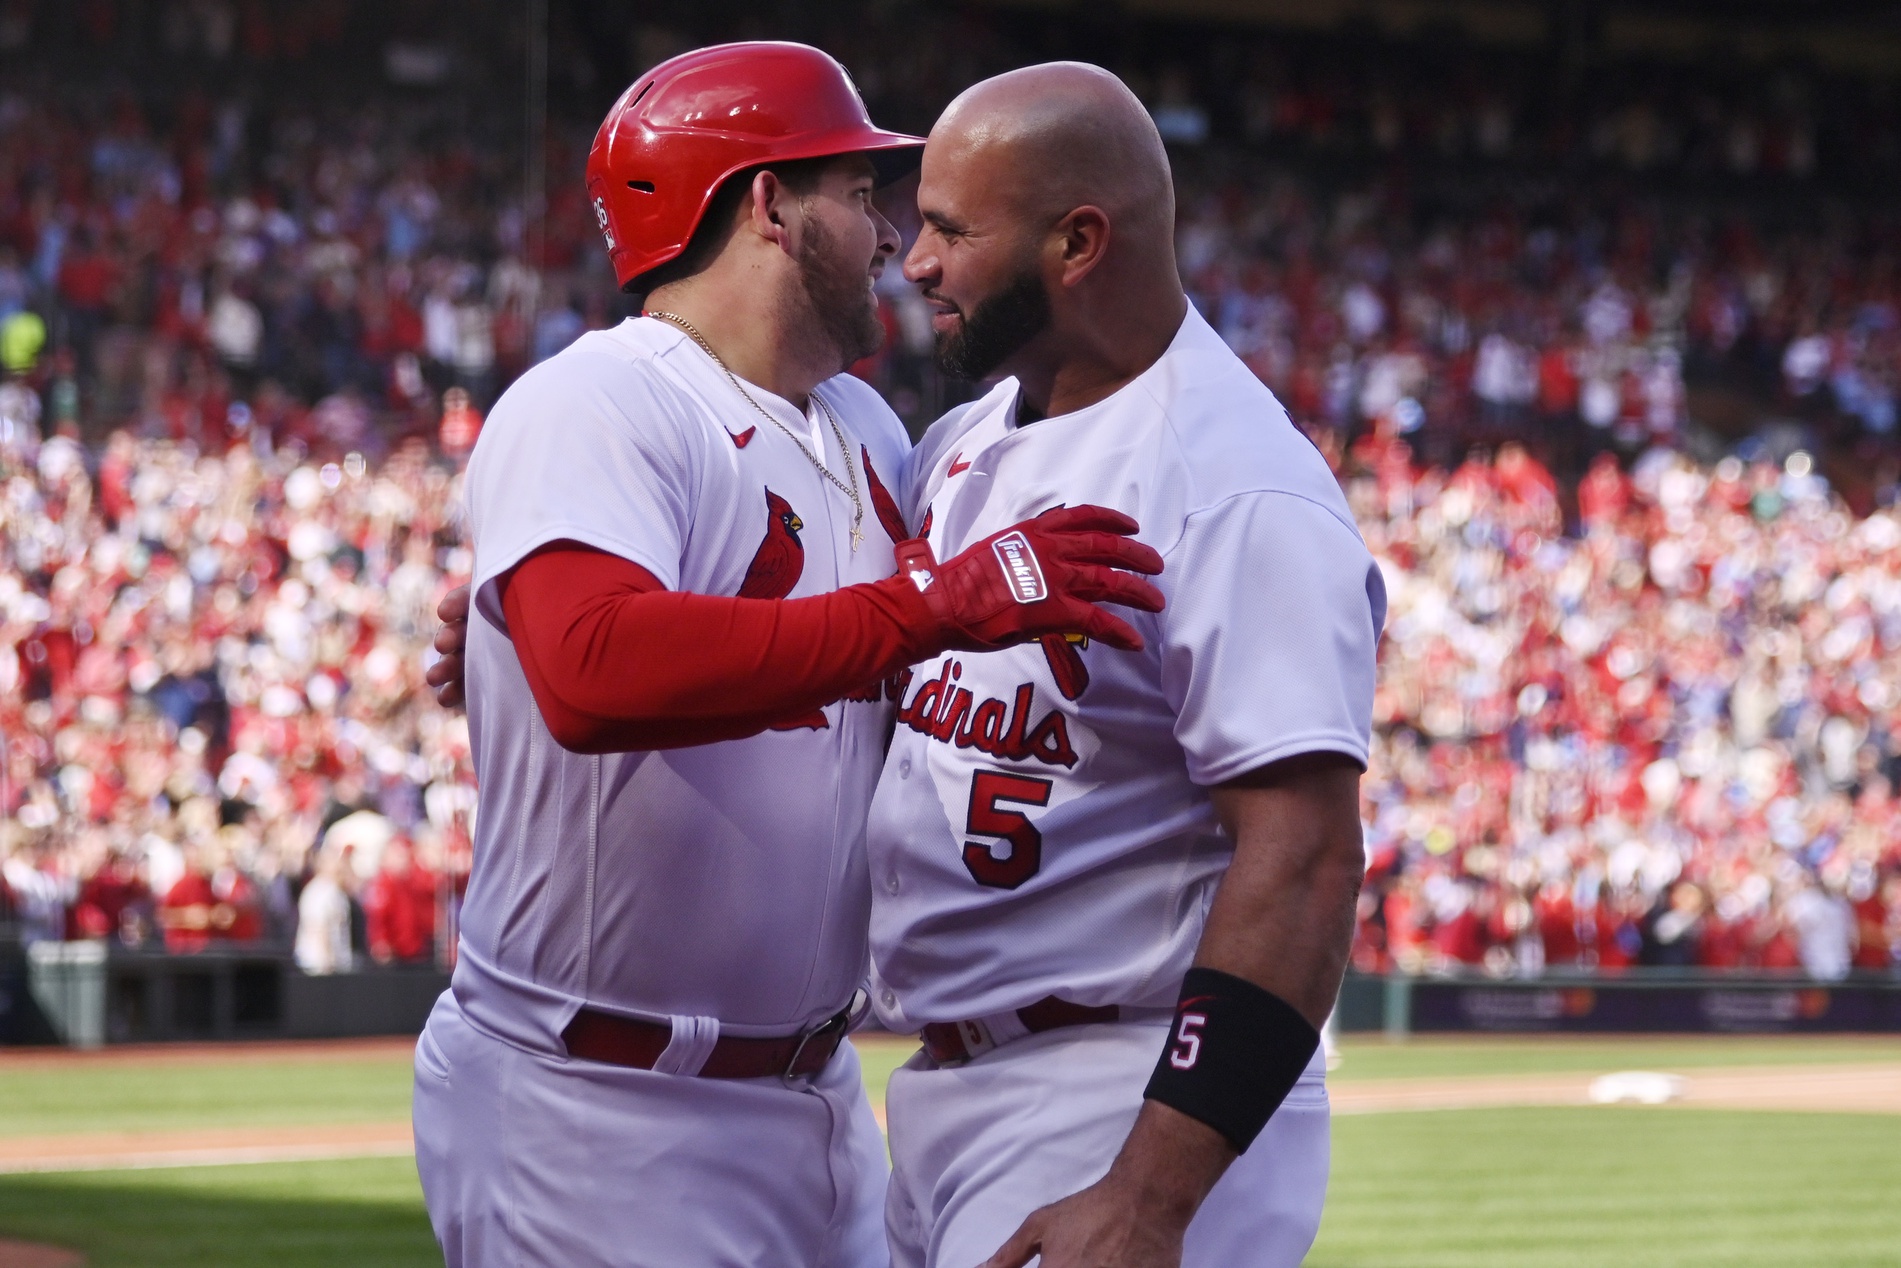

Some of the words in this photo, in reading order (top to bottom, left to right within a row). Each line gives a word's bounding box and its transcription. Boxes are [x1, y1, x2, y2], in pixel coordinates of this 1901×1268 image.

[997, 540, 1038, 598] Franklin
[899, 657, 1079, 770] dinals
[962, 768, 1053, 890] 5
[1170, 1014, 1206, 1069] 5
